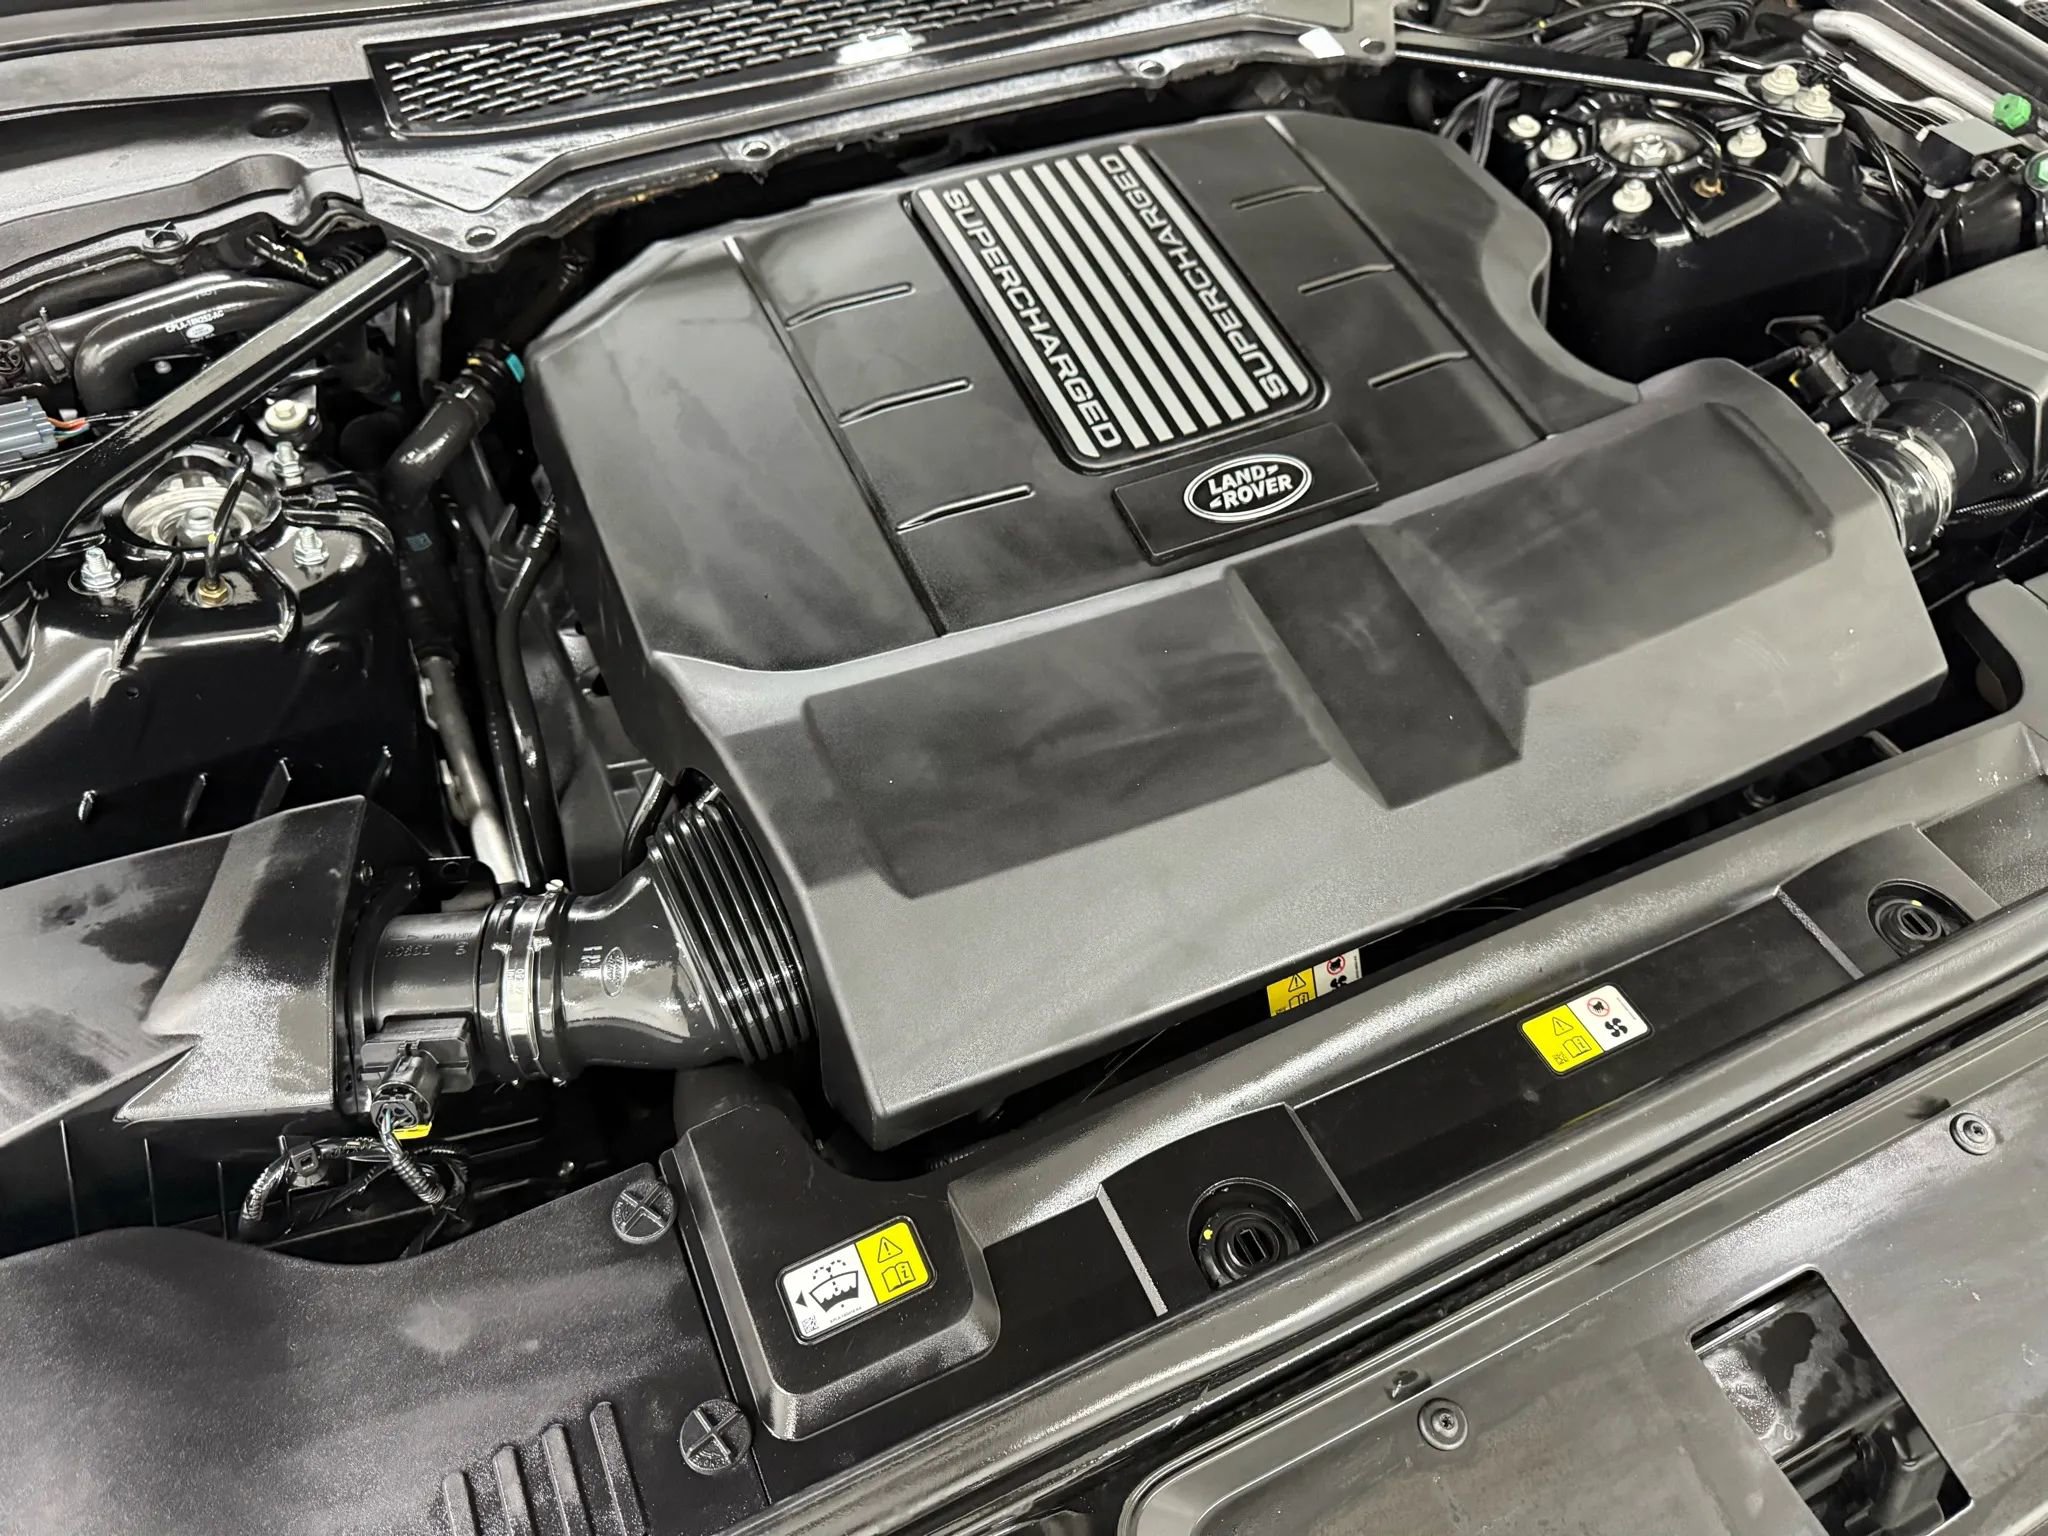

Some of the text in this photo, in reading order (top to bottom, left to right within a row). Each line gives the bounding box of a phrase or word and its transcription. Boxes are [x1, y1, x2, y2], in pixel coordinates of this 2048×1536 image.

[943, 187, 1123, 450] SUPERCHARGED
[1102, 153, 1289, 400] SUPERCHARGED
[1207, 464, 1266, 496] LAND
[1222, 474, 1294, 510] ROVER
